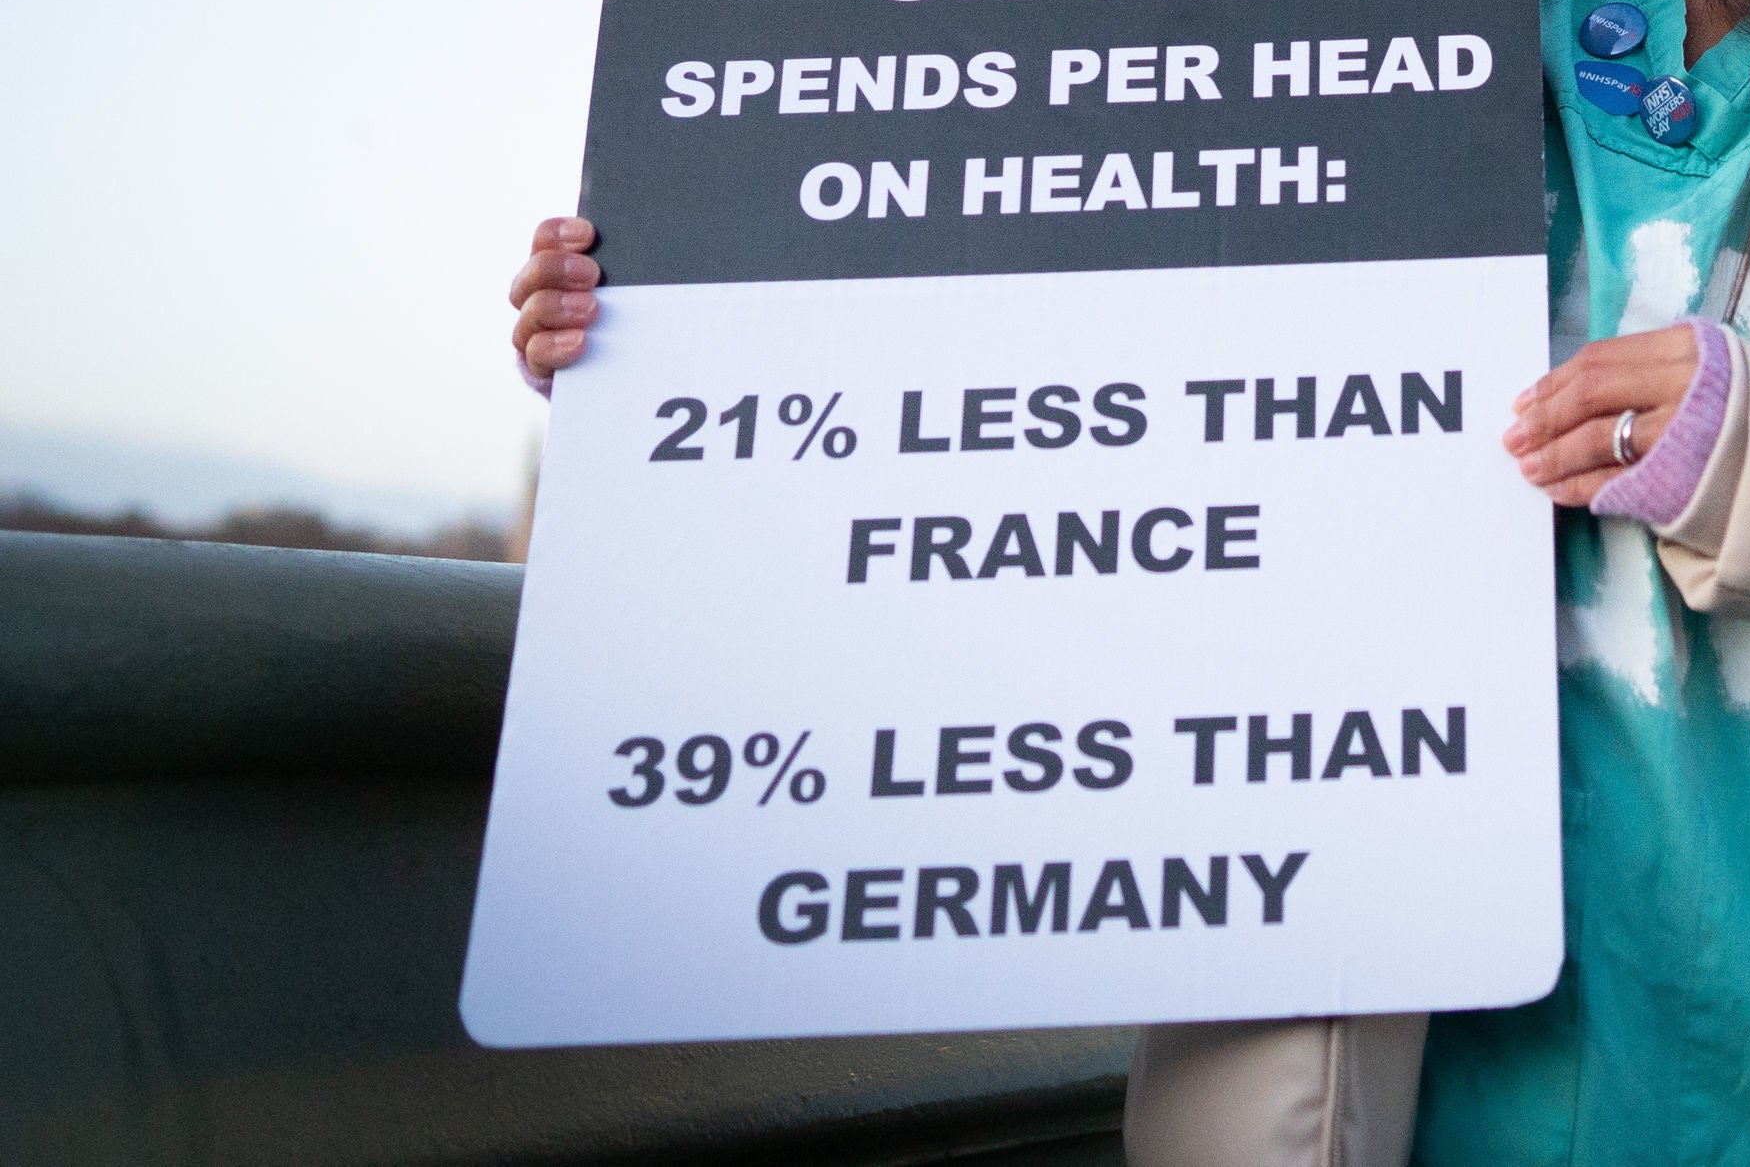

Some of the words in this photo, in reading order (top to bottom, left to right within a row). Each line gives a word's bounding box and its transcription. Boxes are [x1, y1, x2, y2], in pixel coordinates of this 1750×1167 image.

[660, 51, 1018, 118] SPENDS
[1048, 44, 1223, 106] PER
[1252, 34, 1493, 99] HEAD
[1646, 85, 1671, 110] NHS
[1647, 92, 1685, 127] WORKERS
[1652, 117, 1670, 139] SAY
[799, 159, 930, 221] ON
[961, 148, 1347, 216] HEALTH:
[649, 390, 857, 462] 21%
[899, 379, 1148, 453] LESS
[1185, 370, 1463, 442] THAN
[847, 505, 1260, 584] FRANCE
[608, 730, 826, 808] 39%
[870, 720, 1133, 798] LESS
[1174, 706, 1466, 785] THAN
[757, 852, 1309, 946] GERMANY
